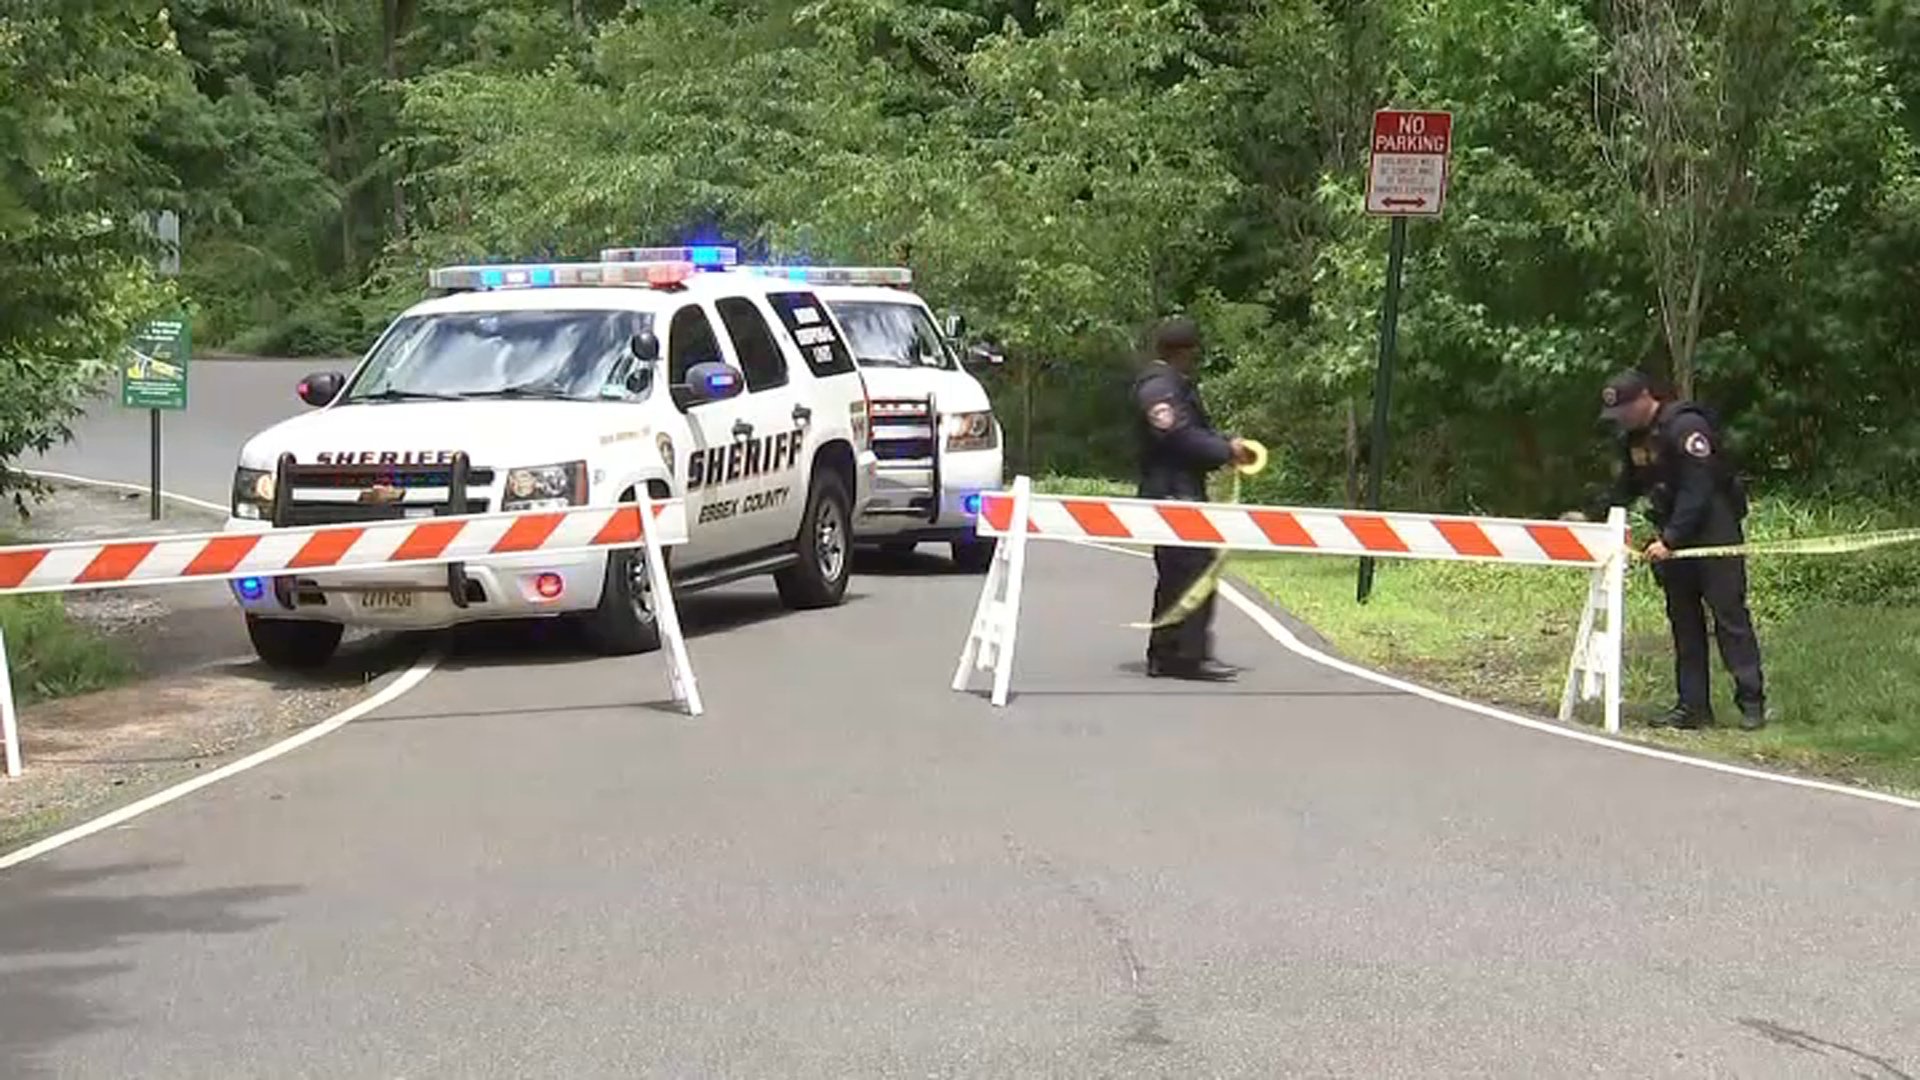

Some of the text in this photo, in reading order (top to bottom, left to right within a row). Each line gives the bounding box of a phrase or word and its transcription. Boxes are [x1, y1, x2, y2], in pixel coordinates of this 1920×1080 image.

[1399, 115, 1426, 135] NO
[1375, 135, 1445, 152] PARKING
[316, 451, 453, 466] SHERIFF
[687, 429, 803, 492] SHERIFF
[698, 486, 790, 524] ESSEX COUNTY
